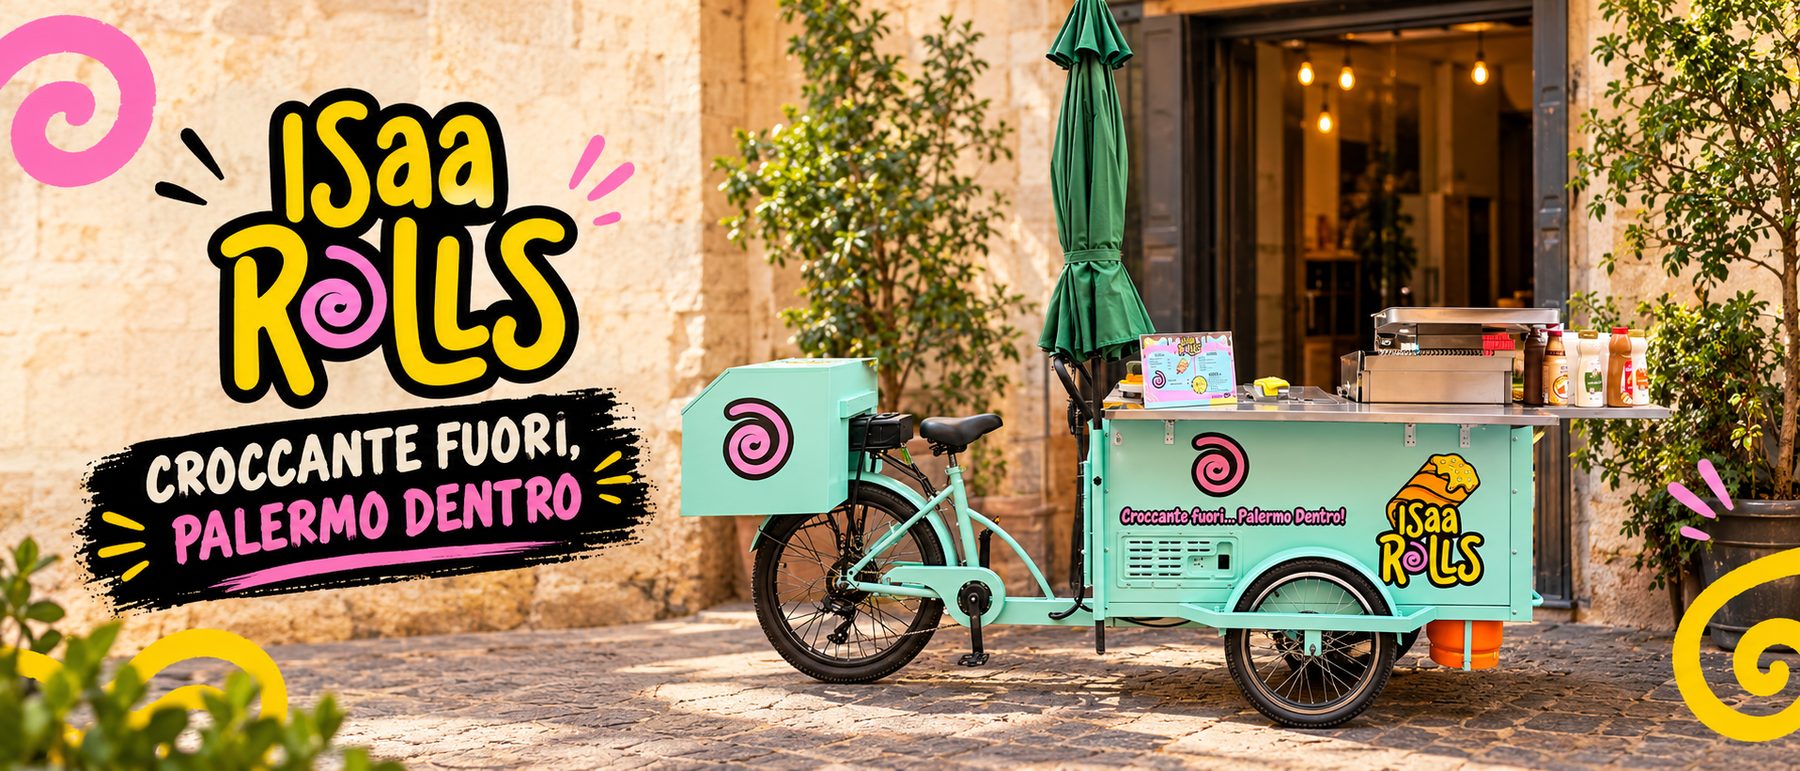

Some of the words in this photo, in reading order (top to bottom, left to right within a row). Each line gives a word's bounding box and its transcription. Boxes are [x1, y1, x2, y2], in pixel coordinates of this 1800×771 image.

[1120, 507, 1189, 525] Croccante
[1190, 507, 1236, 525] fuori...
[1237, 507, 1292, 525] Palermo
[1294, 507, 1348, 525] Dentro!
[1378, 533, 1483, 586] ROLLS
